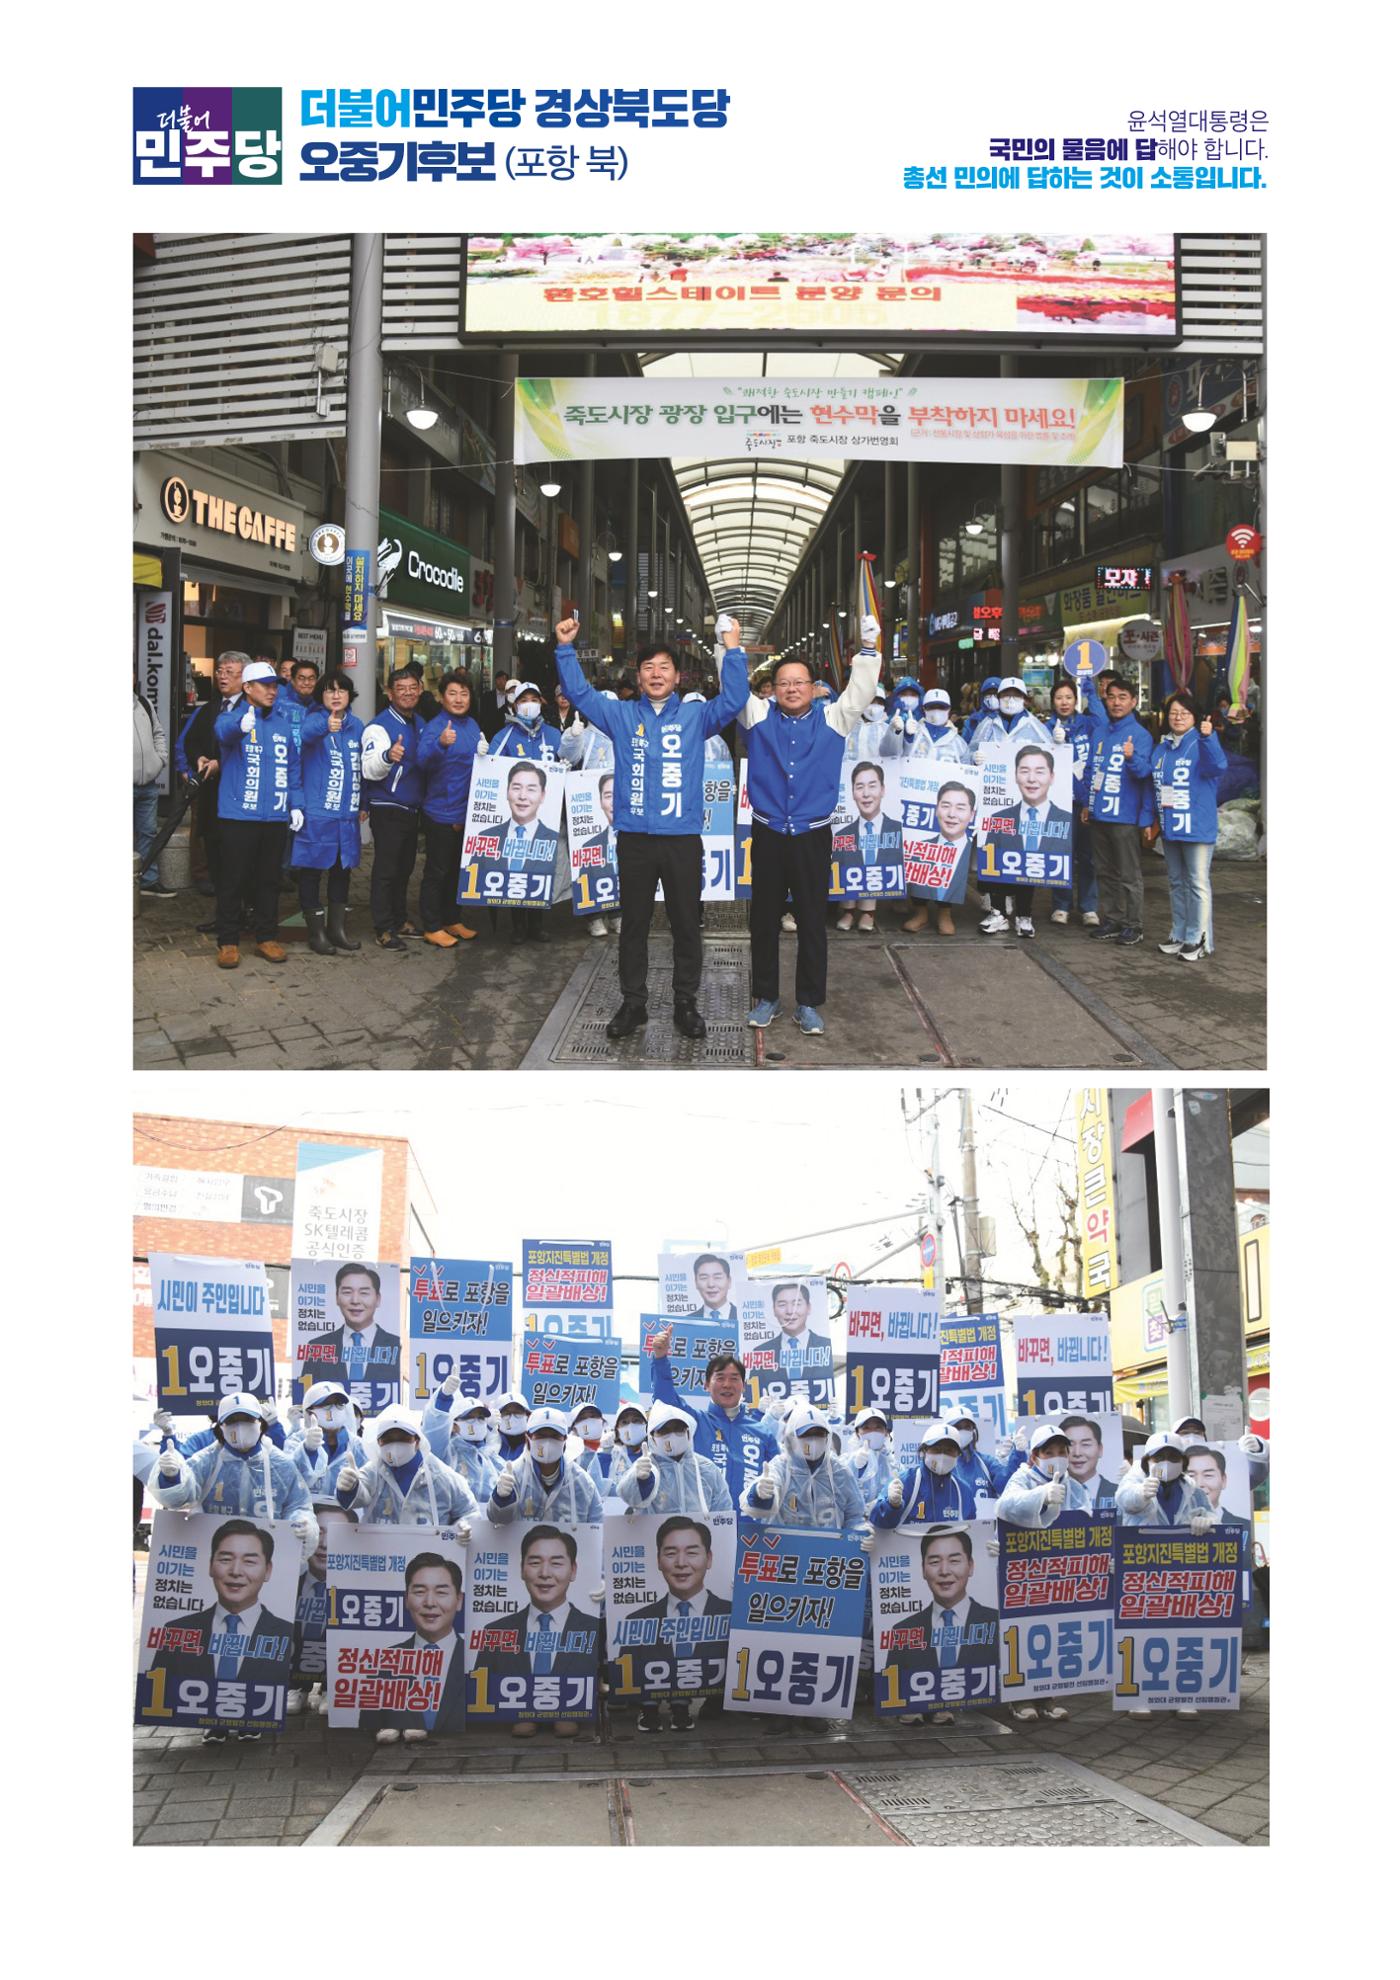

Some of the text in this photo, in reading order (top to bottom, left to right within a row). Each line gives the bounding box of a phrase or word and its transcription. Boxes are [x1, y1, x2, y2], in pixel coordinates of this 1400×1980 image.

[796, 286, 863, 302] 분양
[877, 286, 942, 301] 문의
[564, 404, 1076, 430] 죽도시장 광장 입구에는 현수막을 부착하지 마세요!
[787, 435, 806, 445] 포항
[809, 435, 848, 446] 죽도시장
[192, 489, 237, 535] THE
[238, 505, 296, 552] CAFFE
[408, 550, 464, 593] Crocodile
[1076, 641, 1093, 669] 1
[273, 744, 289, 812] 오중기
[661, 734, 683, 818] 오중기
[983, 764, 1007, 774] 시민을
[983, 775, 1007, 785] 이기는
[476, 777, 500, 788] 시민을
[630, 748, 645, 816] 국회의원 후보
[983, 786, 1006, 795] 정치는
[1101, 753, 1126, 816] 오중기
[473, 801, 496, 811] 정치는
[474, 790, 497, 800] 이기는
[982, 796, 1014, 806] 없습니다
[1172, 767, 1192, 833] 오중기
[472, 813, 503, 824] 없습니다
[982, 817, 1071, 839] 바꾸면, 바뀝니다!
[464, 836, 557, 861] 바꾸면, 바뀝니다!
[981, 843, 1070, 880] 1 오중기
[461, 863, 552, 901] 1 오중기
[846, 865, 904, 892] 오중기
[309, 1205, 368, 1225] 죽도시장
[305, 1223, 369, 1242] SK텔레콤
[305, 1241, 367, 1260] 공식인증
[591, 1251, 609, 1266] 개정
[297, 1283, 326, 1294] 시민을
[529, 1269, 608, 1285] 정신적피해
[157, 1279, 266, 1316] 시민이 주인입니다
[297, 1296, 326, 1306] 이기는
[413, 1279, 510, 1305] 투표로 포항을
[297, 1308, 326, 1319] 정치는
[297, 1321, 335, 1331] 없습니다
[848, 1310, 938, 1341] 바꾸면, 바뀝니다!
[1018, 1337, 1054, 1366] 바꾸면,
[162, 1345, 273, 1396] 1 오중기
[525, 1353, 618, 1380] 투표로 포항을
[870, 1367, 938, 1413] 오중기
[741, 1434, 761, 1445] 민주당
[712, 1517, 733, 1526] 민주당
[916, 1502, 925, 1520] 1
[612, 1545, 645, 1558] 시민을
[1006, 1525, 1112, 1553] 포항지진특별법 개정
[158, 1544, 198, 1560] 시민을
[327, 1554, 406, 1573] 포항지진특별법 개정
[1122, 1541, 1238, 1565] 포항지진특별법 개정
[156, 1561, 195, 1577] 이기는
[612, 1561, 645, 1574] 이기는
[738, 1551, 866, 1590] 투표로 포항을
[1006, 1553, 1111, 1581] 정신적피해
[154, 1579, 193, 1594] 정치는
[613, 1577, 645, 1589] 정치는
[1004, 1576, 1108, 1609] 일괄배상!
[1121, 1570, 1236, 1594] 정신적피해
[153, 1595, 204, 1612] 없습니다
[327, 1586, 340, 1626] 1
[341, 1595, 404, 1628] 오중기
[613, 1591, 657, 1605] 없습니다
[747, 1592, 835, 1629] 일으키자!
[1119, 1593, 1234, 1620] 일괄배상!
[147, 1627, 203, 1656] 바꾸면,
[208, 1633, 290, 1661] 바뀝니다!
[613, 1618, 658, 1646] 시민이
[337, 1647, 444, 1677] 정신적피해
[1003, 1618, 1113, 1688] 1 오중기
[614, 1654, 641, 1696] 1
[731, 1647, 855, 1709] 1 오중기
[1116, 1636, 1239, 1696] 1 오중기
[141, 1667, 286, 1721] 1 오중기
[333, 1678, 442, 1711] 일괄배상!
